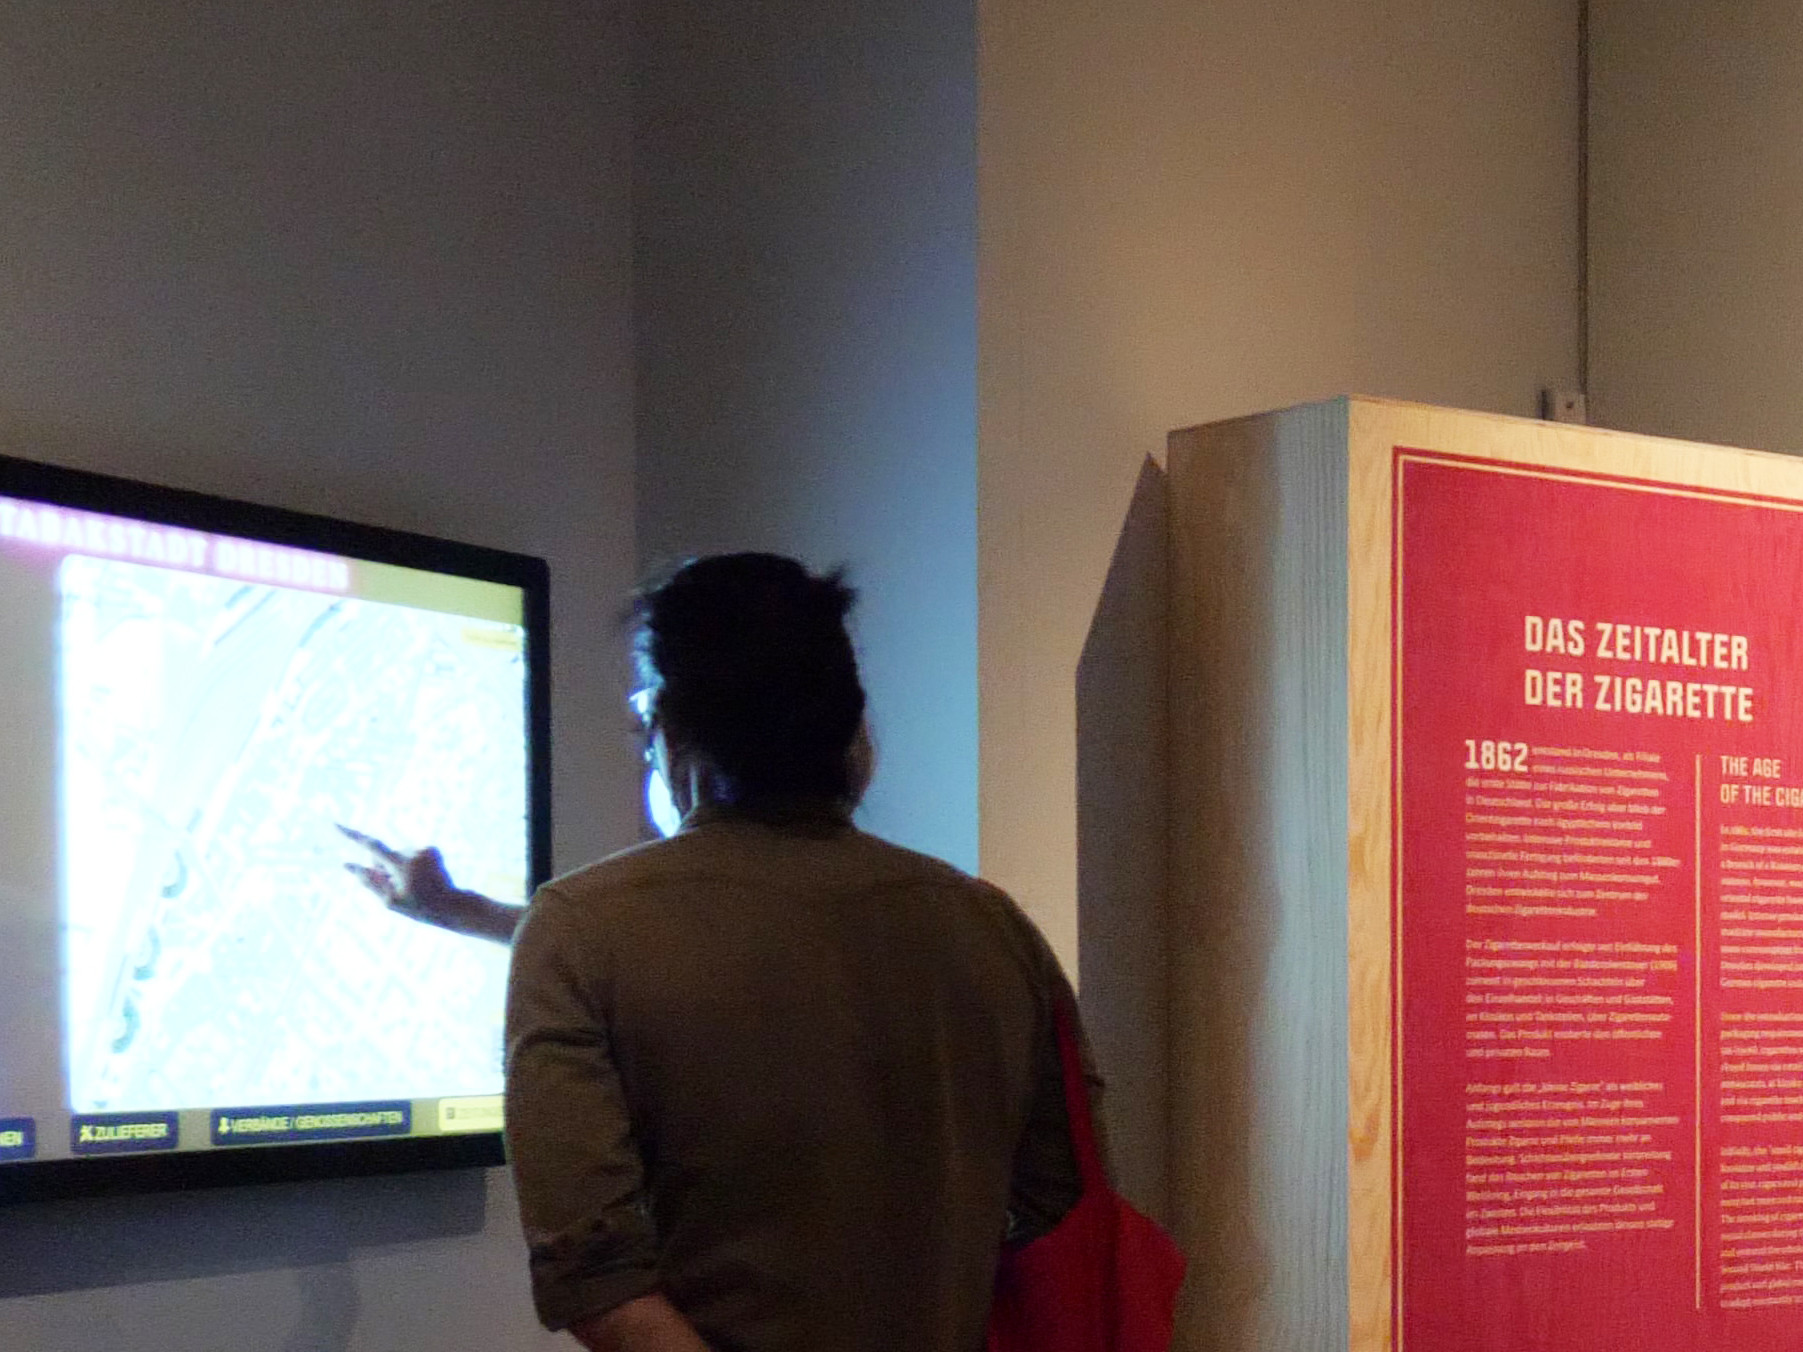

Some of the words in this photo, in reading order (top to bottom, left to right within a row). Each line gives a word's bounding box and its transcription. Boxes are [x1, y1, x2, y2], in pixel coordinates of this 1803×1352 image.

[214, 538, 350, 591] DRESDEN
[1524, 615, 1585, 657] DAS
[1595, 622, 1749, 670] ZEITALTER
[1524, 669, 1583, 709] DER
[1594, 676, 1754, 722] ZIGARETTE
[1464, 739, 1529, 773] 1862
[1720, 756, 1748, 777] THE
[1752, 758, 1781, 779] AGE
[1720, 784, 1739, 804] OF
[1744, 785, 1771, 806] THE
